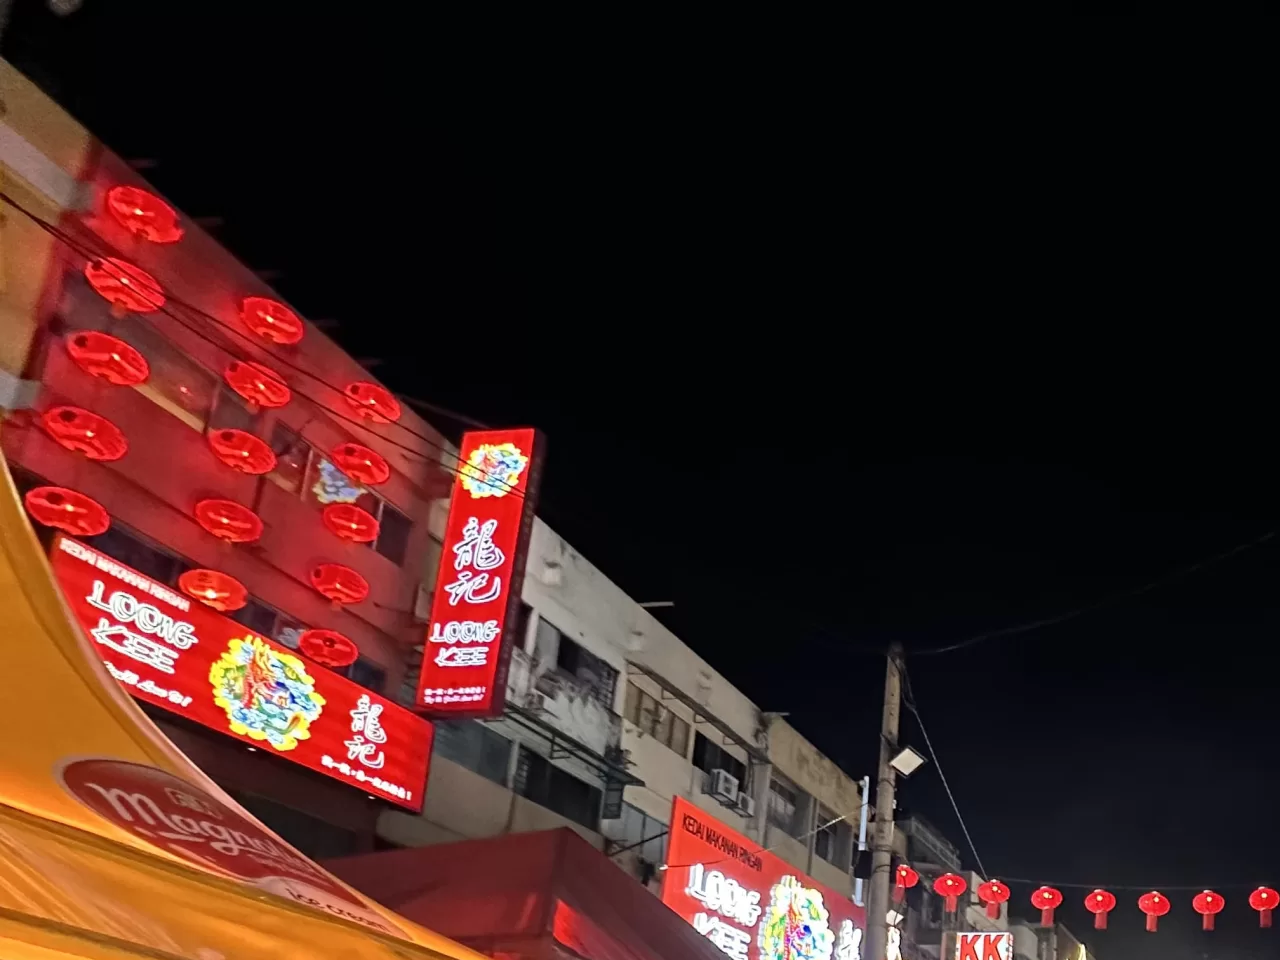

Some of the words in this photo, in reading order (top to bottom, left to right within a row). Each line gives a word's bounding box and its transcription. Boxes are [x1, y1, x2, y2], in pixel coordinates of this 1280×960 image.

[85, 579, 199, 650] LOONG
[429, 620, 500, 643] LOONG
[90, 617, 179, 674] KEE
[434, 646, 489, 667] KEE
[685, 863, 762, 927] LOONG
